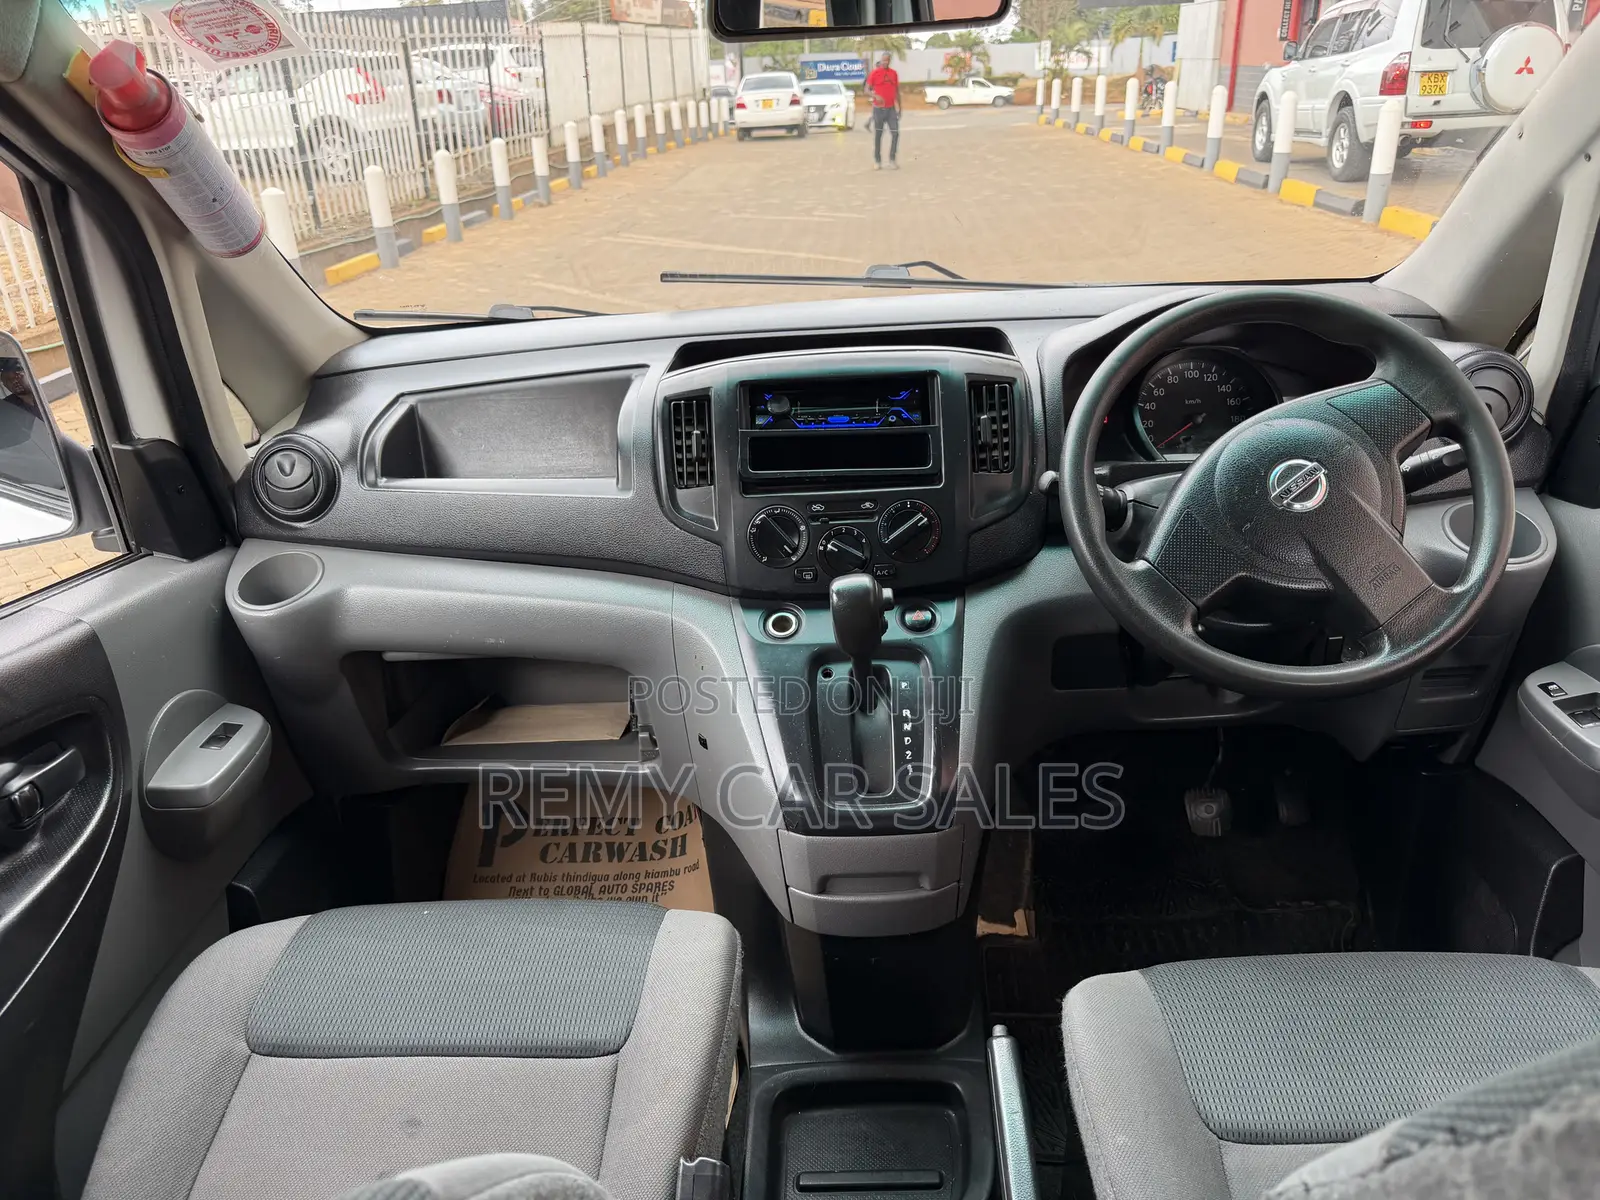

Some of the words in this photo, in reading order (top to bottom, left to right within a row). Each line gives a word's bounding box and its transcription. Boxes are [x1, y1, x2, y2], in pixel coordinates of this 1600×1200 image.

[1280, 10, 1291, 38] COLLECT
[265, 22, 279, 49] DRIVE
[187, 38, 267, 58] CAREFULLY
[1427, 73, 1446, 84] KBX
[1421, 84, 1445, 94] 937K
[1184, 370, 1199, 379] 100
[1203, 373, 1218, 382] 120
[1167, 376, 1179, 384] 80
[1153, 388, 1165, 396] 60
[1217, 384, 1232, 393] 140
[1144, 402, 1156, 410] 40
[1227, 398, 1241, 406] 160
[1142, 420, 1154, 428] 20
[1278, 466, 1319, 500] NISSAN
[1372, 564, 1401, 590] AIRBAG
[902, 709, 911, 718] R
[903, 722, 912, 731] N
[904, 737, 911, 745] D
[905, 750, 912, 760] 2
[476, 799, 643, 868] PERFECT
[539, 833, 688, 864] CARWASH
[472, 873, 514, 884] Located
[515, 873, 526, 883] at
[530, 872, 558, 882] Rubis
[561, 871, 610, 884] thindigua
[613, 871, 641, 882] along
[644, 867, 681, 879] kiambu
[683, 859, 700, 874] road
[538, 886, 550, 896] to
[553, 884, 594, 897] GLOBAL
[599, 884, 628, 895] AUTO
[631, 880, 675, 893] SPARES
